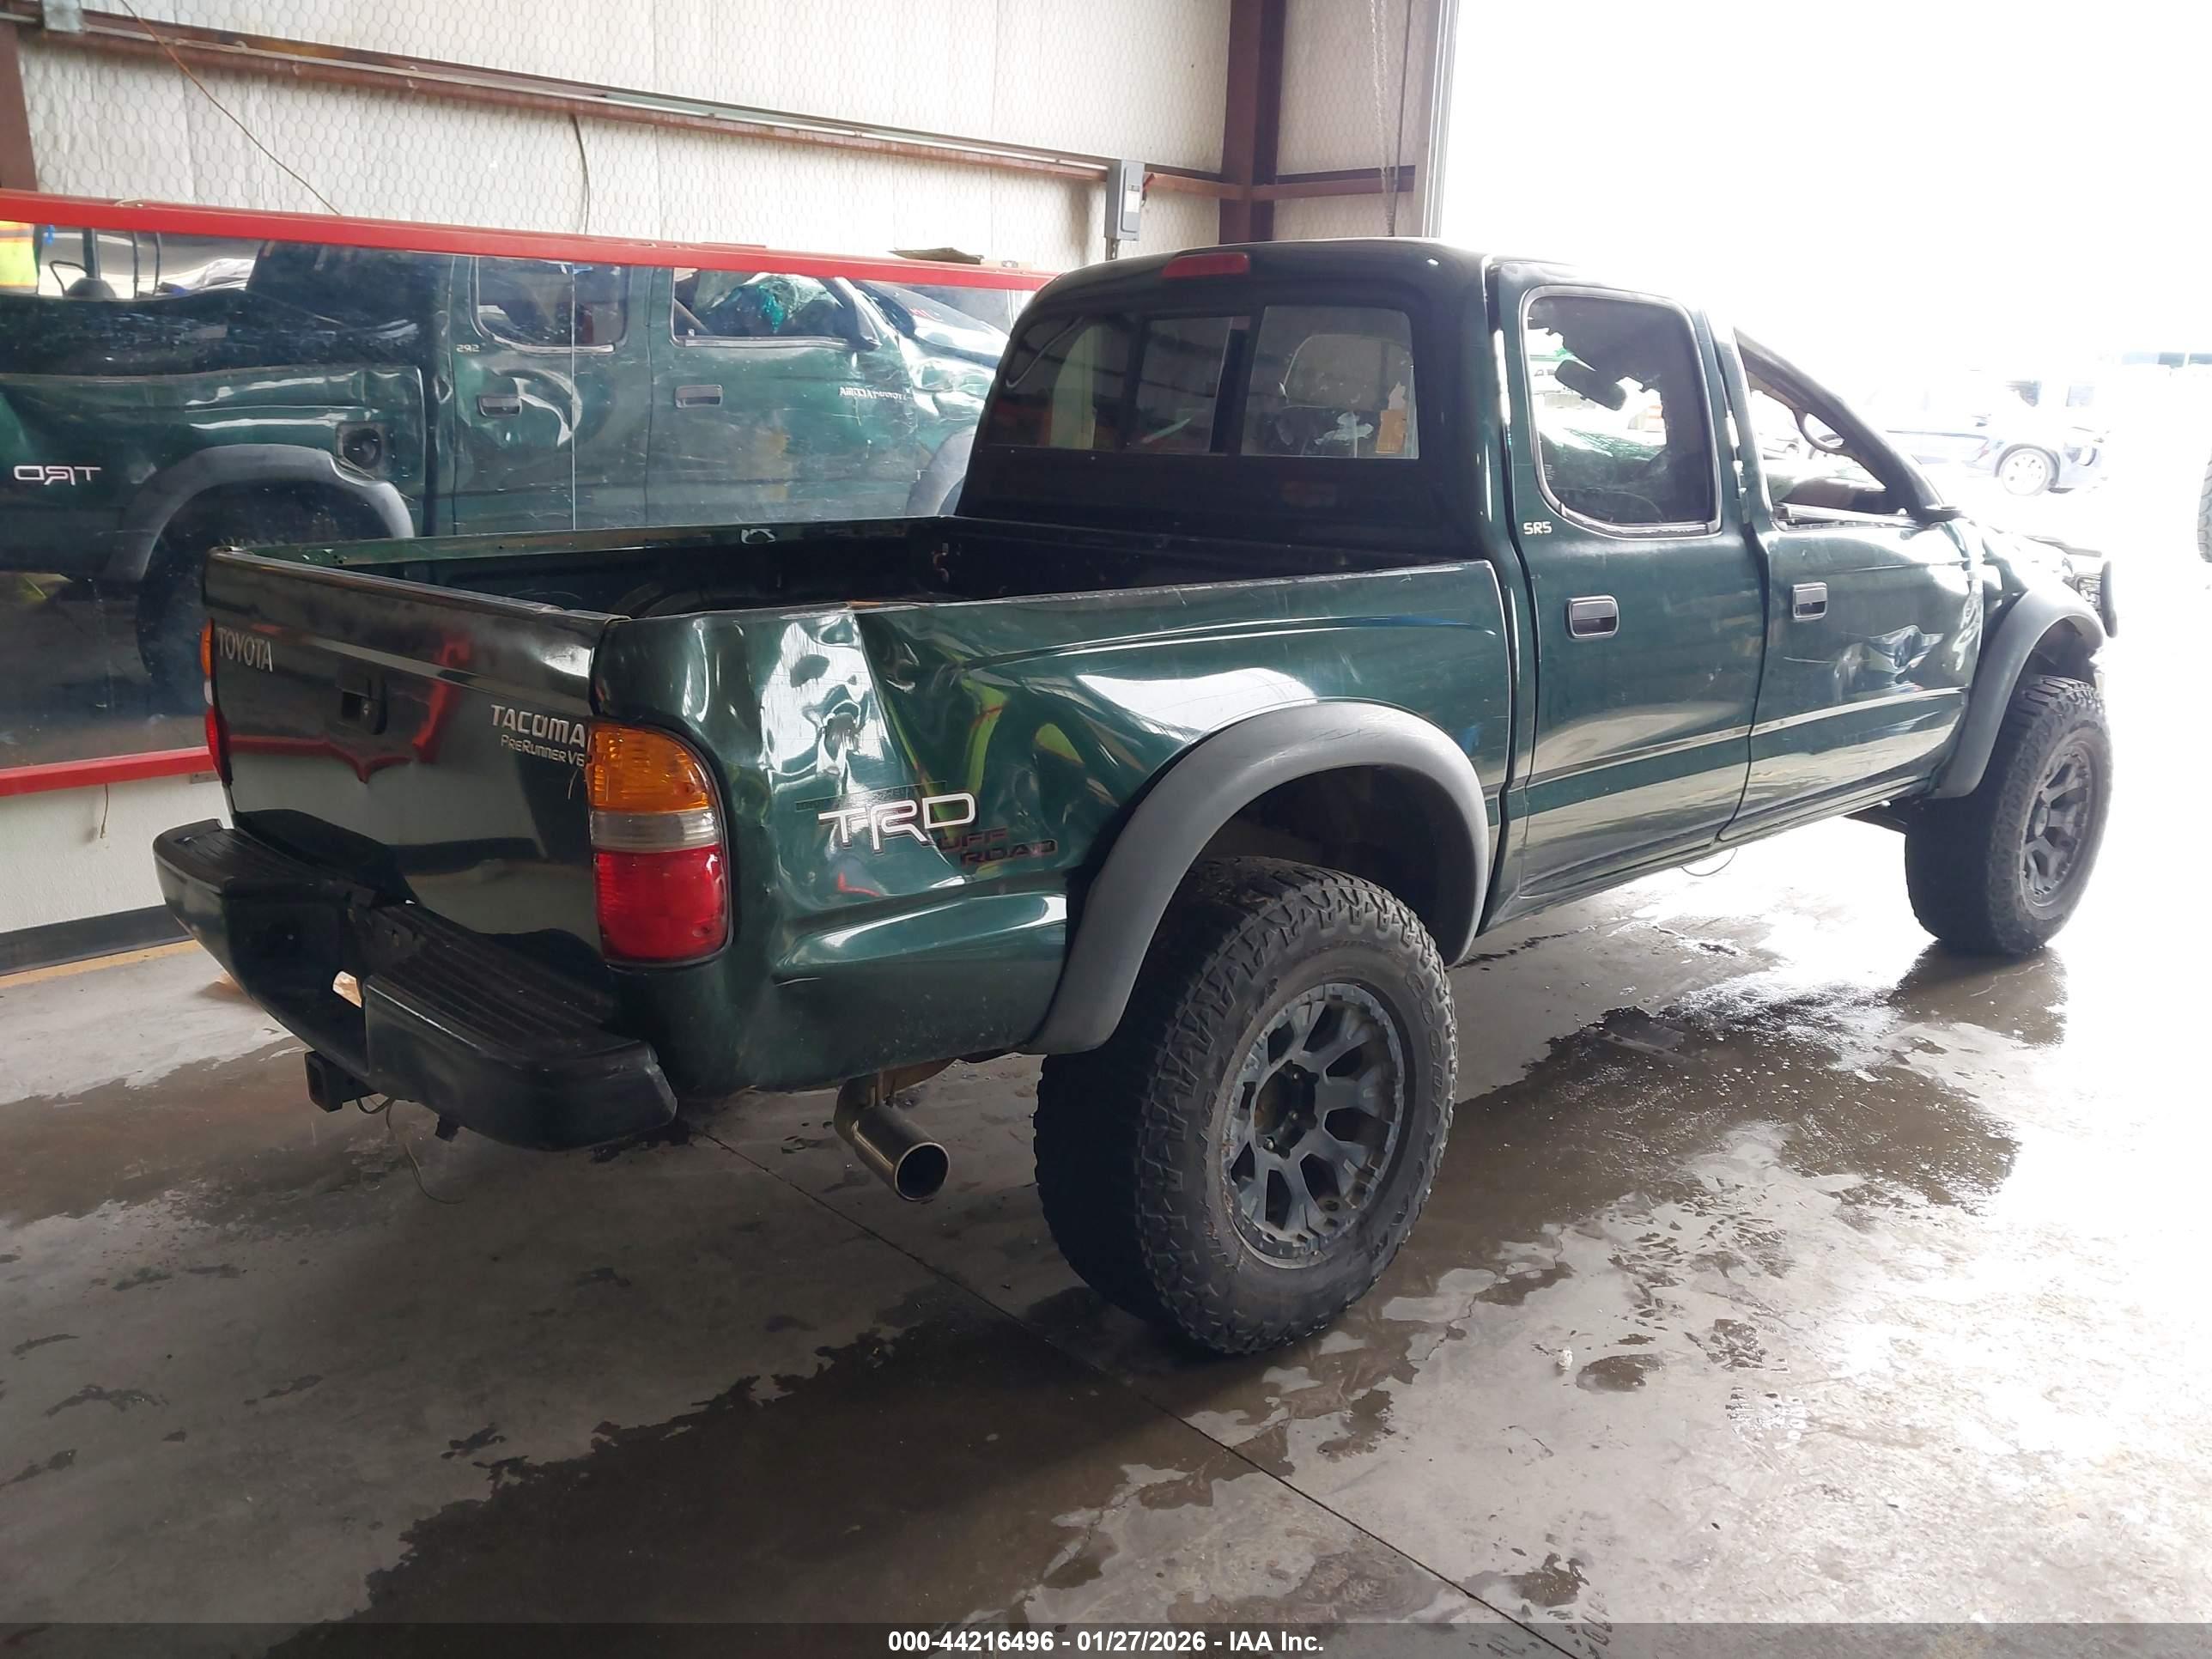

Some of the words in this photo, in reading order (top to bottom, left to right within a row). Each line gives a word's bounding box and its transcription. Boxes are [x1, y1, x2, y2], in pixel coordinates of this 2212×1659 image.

[1523, 520, 1553, 535] SR5
[217, 627, 274, 672] TOYOTA
[490, 704, 586, 748] TACOMA
[568, 750, 586, 767] V6
[817, 792, 977, 854] TRD
[961, 838, 1059, 869] ROAD
